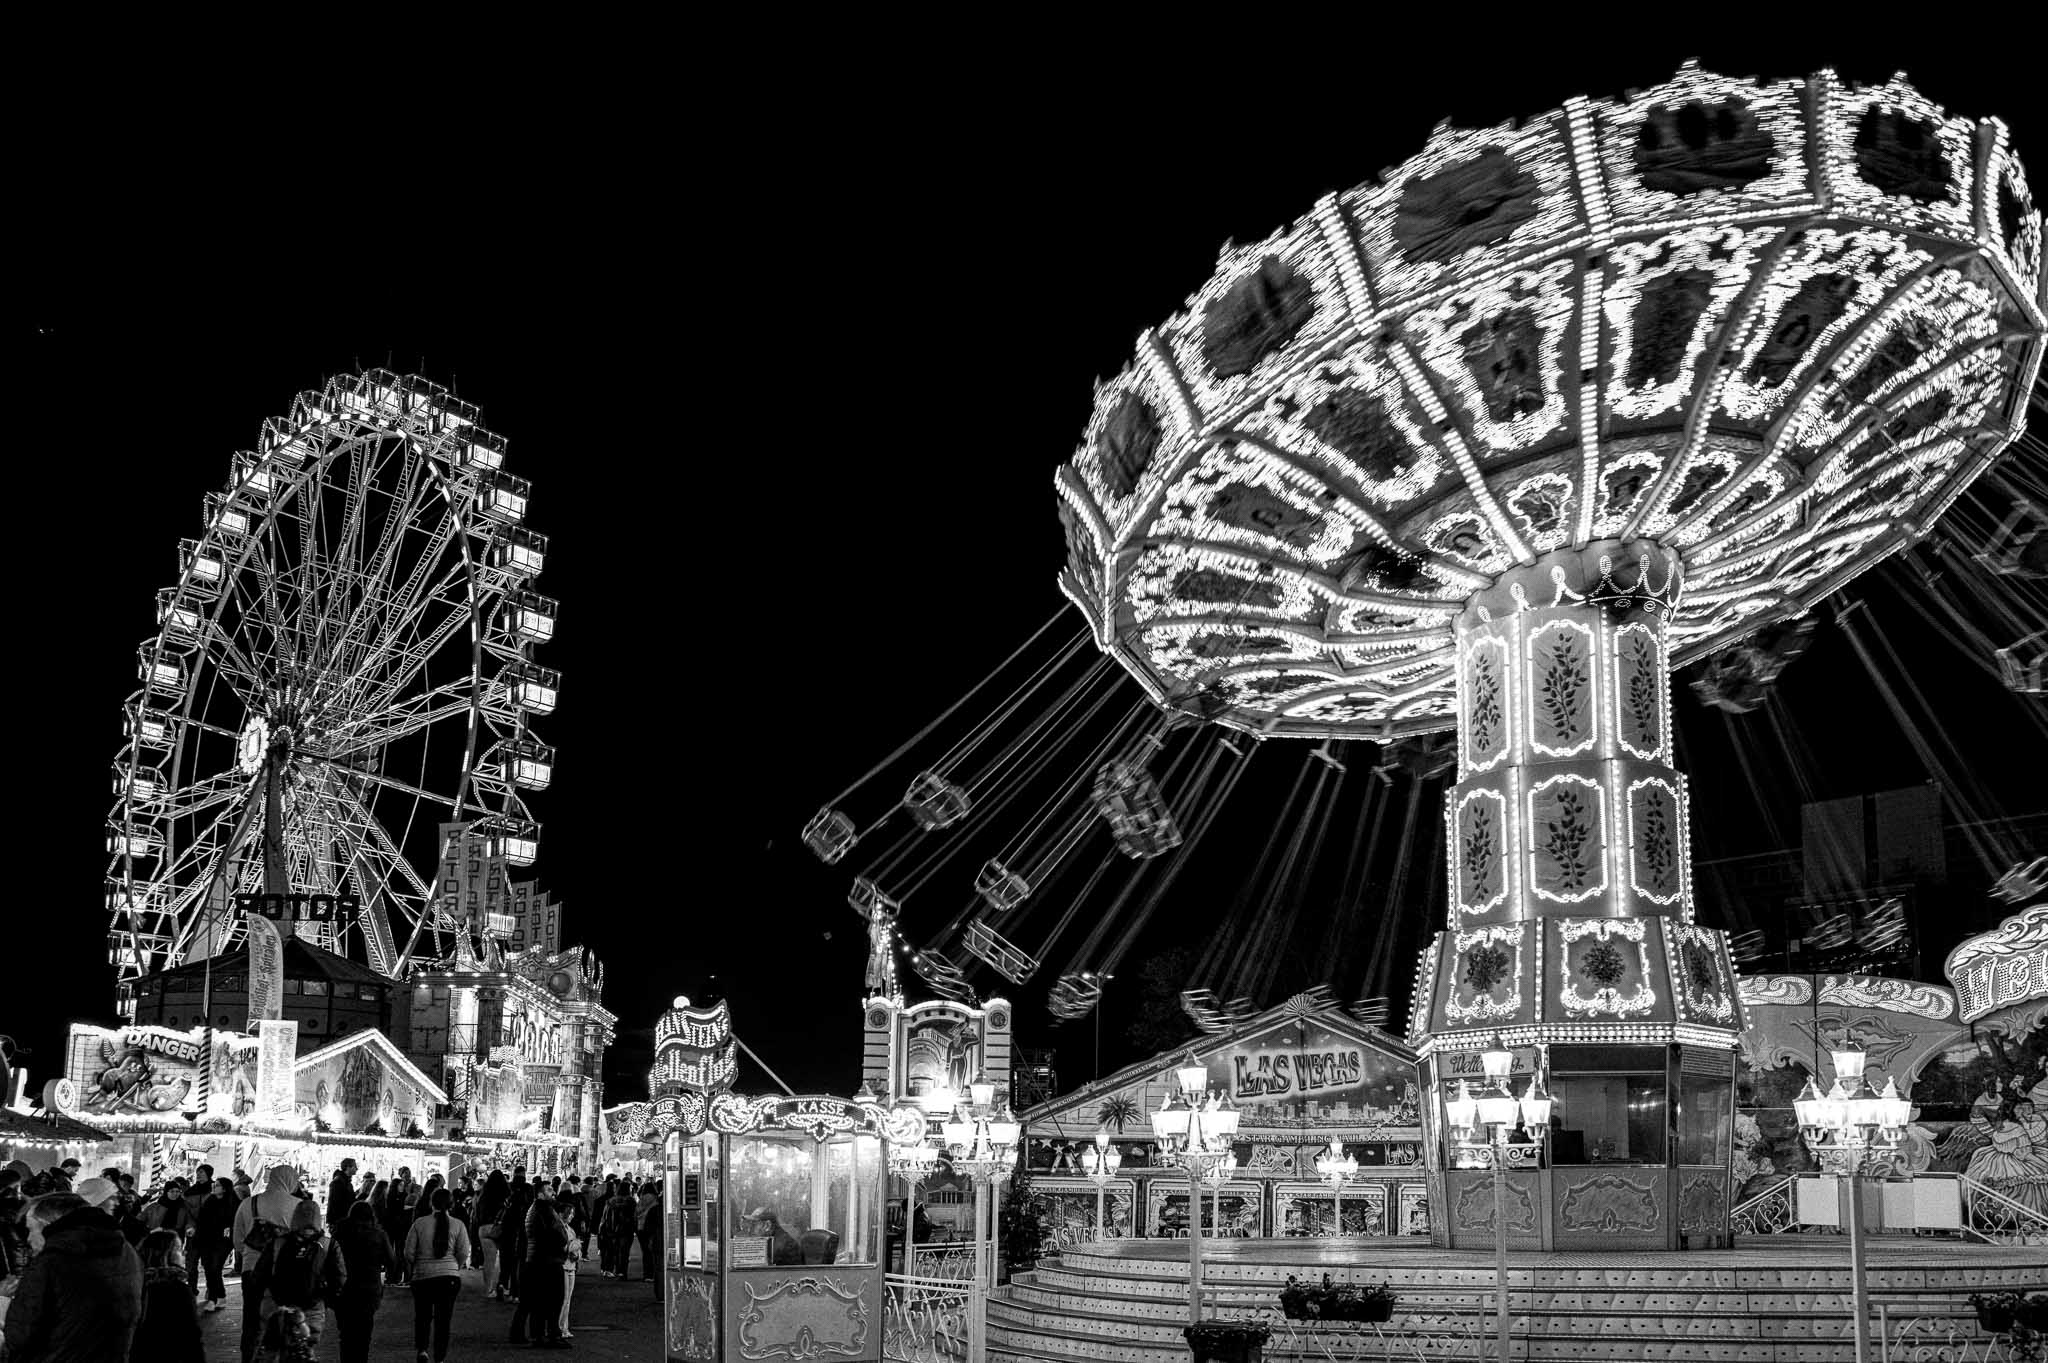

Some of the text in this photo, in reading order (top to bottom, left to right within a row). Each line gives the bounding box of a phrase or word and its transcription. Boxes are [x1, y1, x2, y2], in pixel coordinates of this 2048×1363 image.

[234, 893, 360, 920] ROTOR
[127, 1030, 200, 1062] DANGER
[1234, 1051, 1362, 1098] LAS VEGAS
[797, 1101, 846, 1117] KASSE
